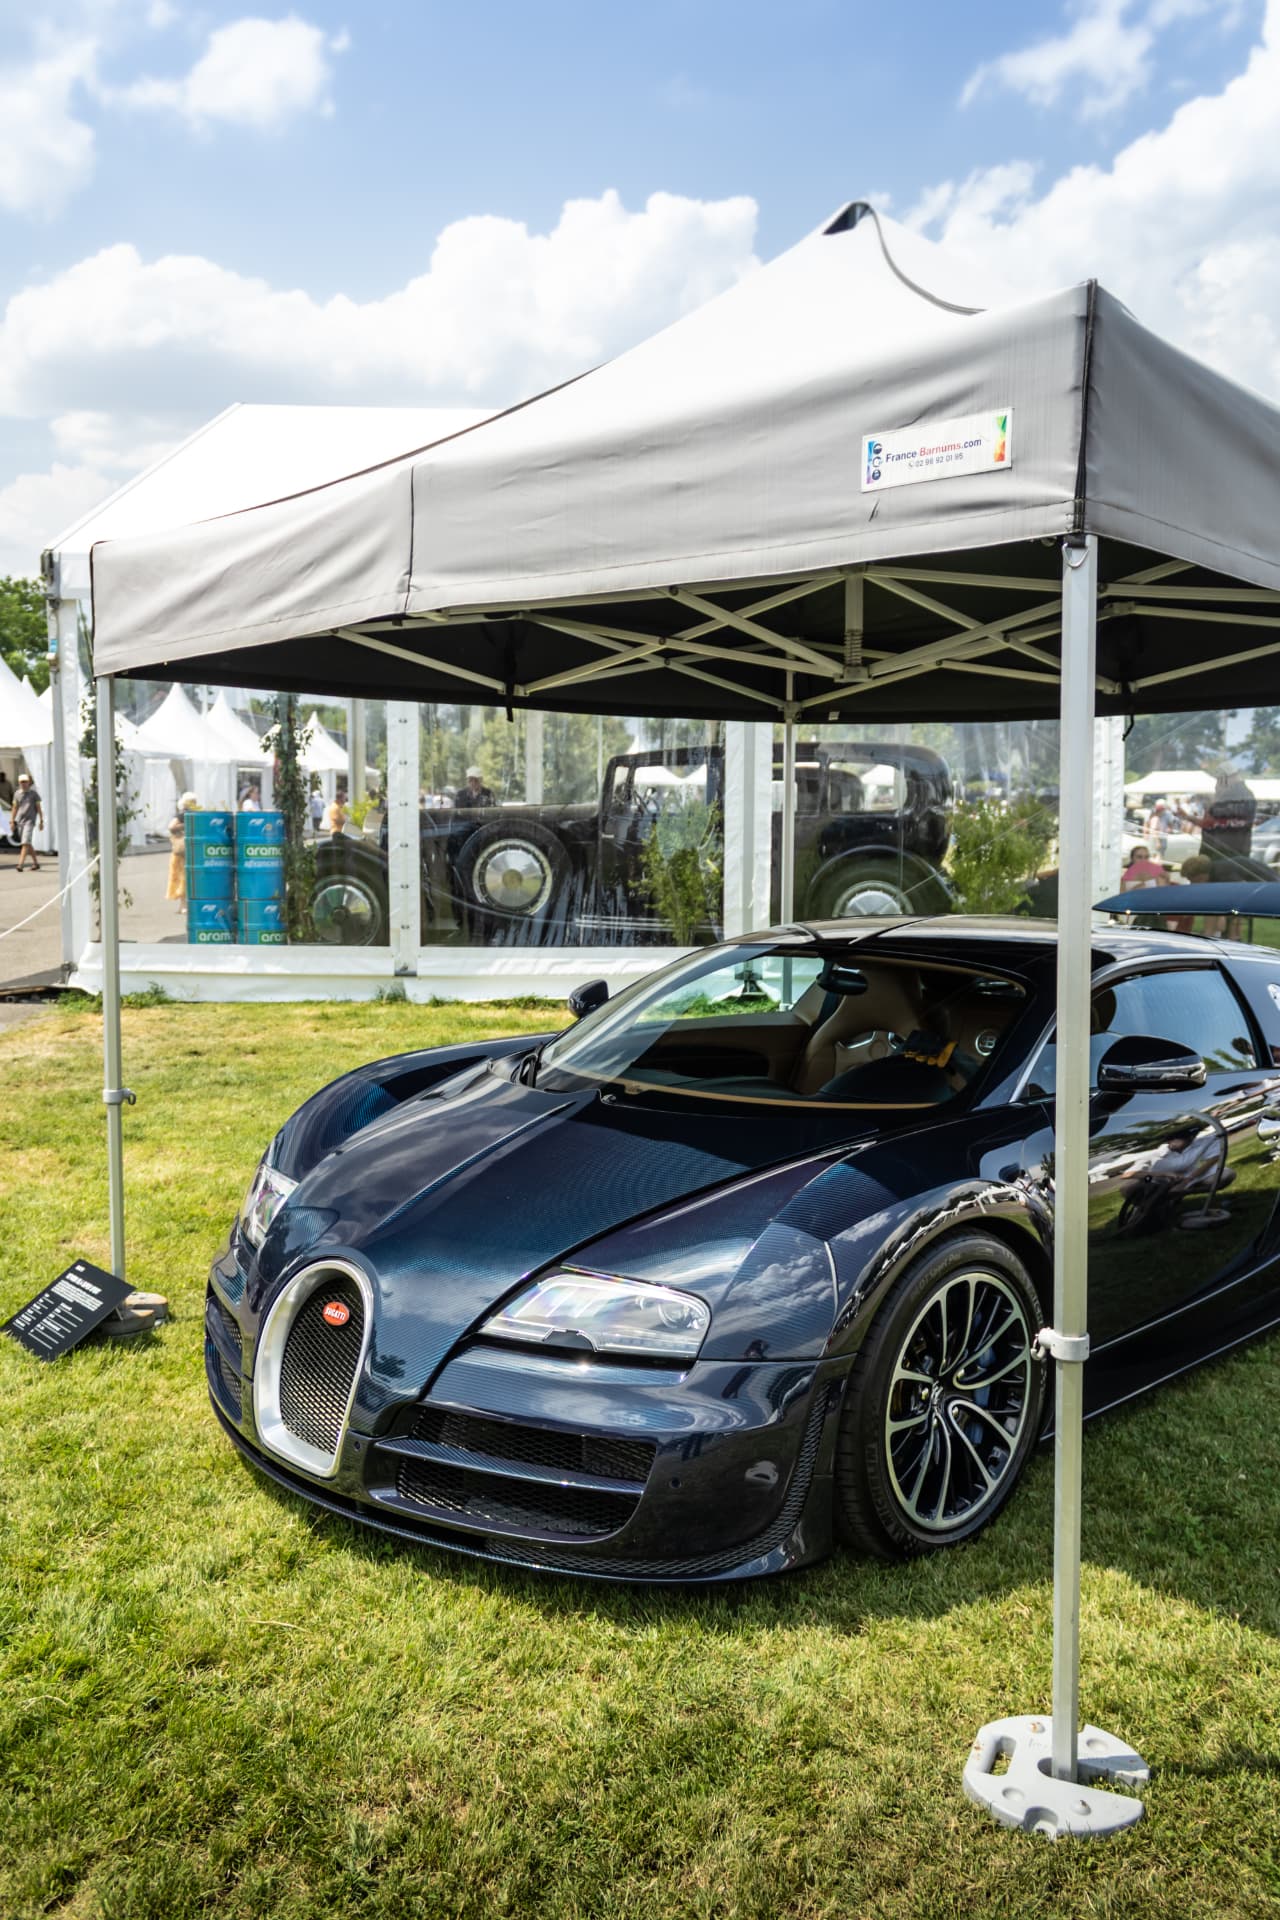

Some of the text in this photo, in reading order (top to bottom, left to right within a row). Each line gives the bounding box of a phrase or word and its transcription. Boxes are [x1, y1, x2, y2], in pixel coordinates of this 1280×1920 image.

[886, 450, 917, 463] France
[919, 439, 982, 457] Barnums.com
[207, 846, 233, 856] ara
